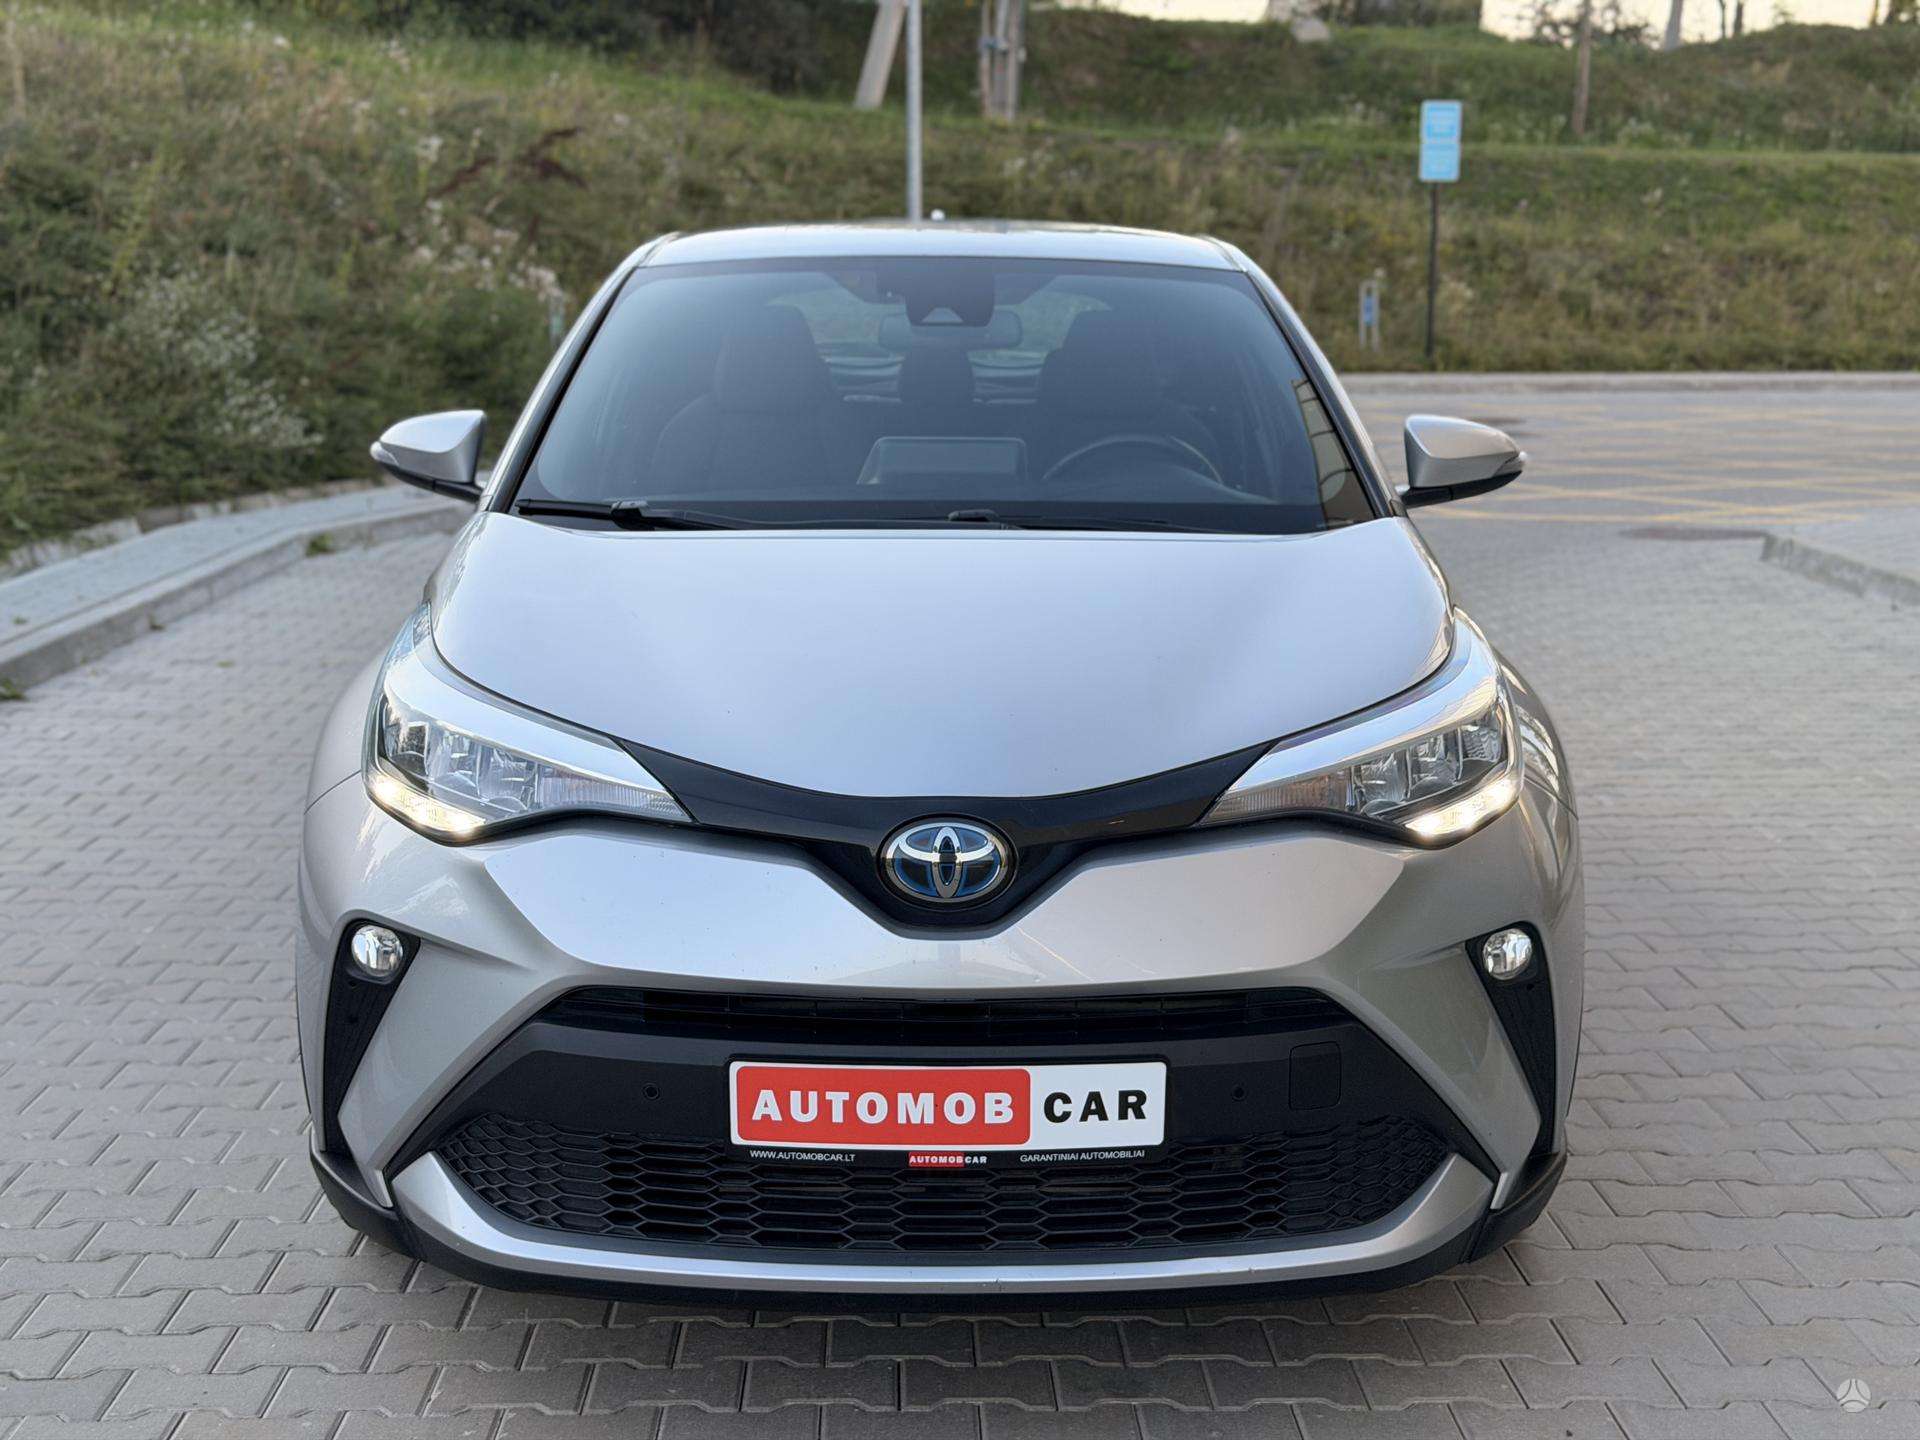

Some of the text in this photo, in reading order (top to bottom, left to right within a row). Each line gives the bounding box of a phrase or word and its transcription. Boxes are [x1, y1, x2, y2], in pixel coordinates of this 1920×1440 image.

[752, 1089, 1147, 1125] AUTOMOB CAR
[750, 1150, 856, 1163] WWW.AUTOMOBCAR.LT
[1020, 1149, 1145, 1163] GARANTINIAI AUTOMOBILIAI
